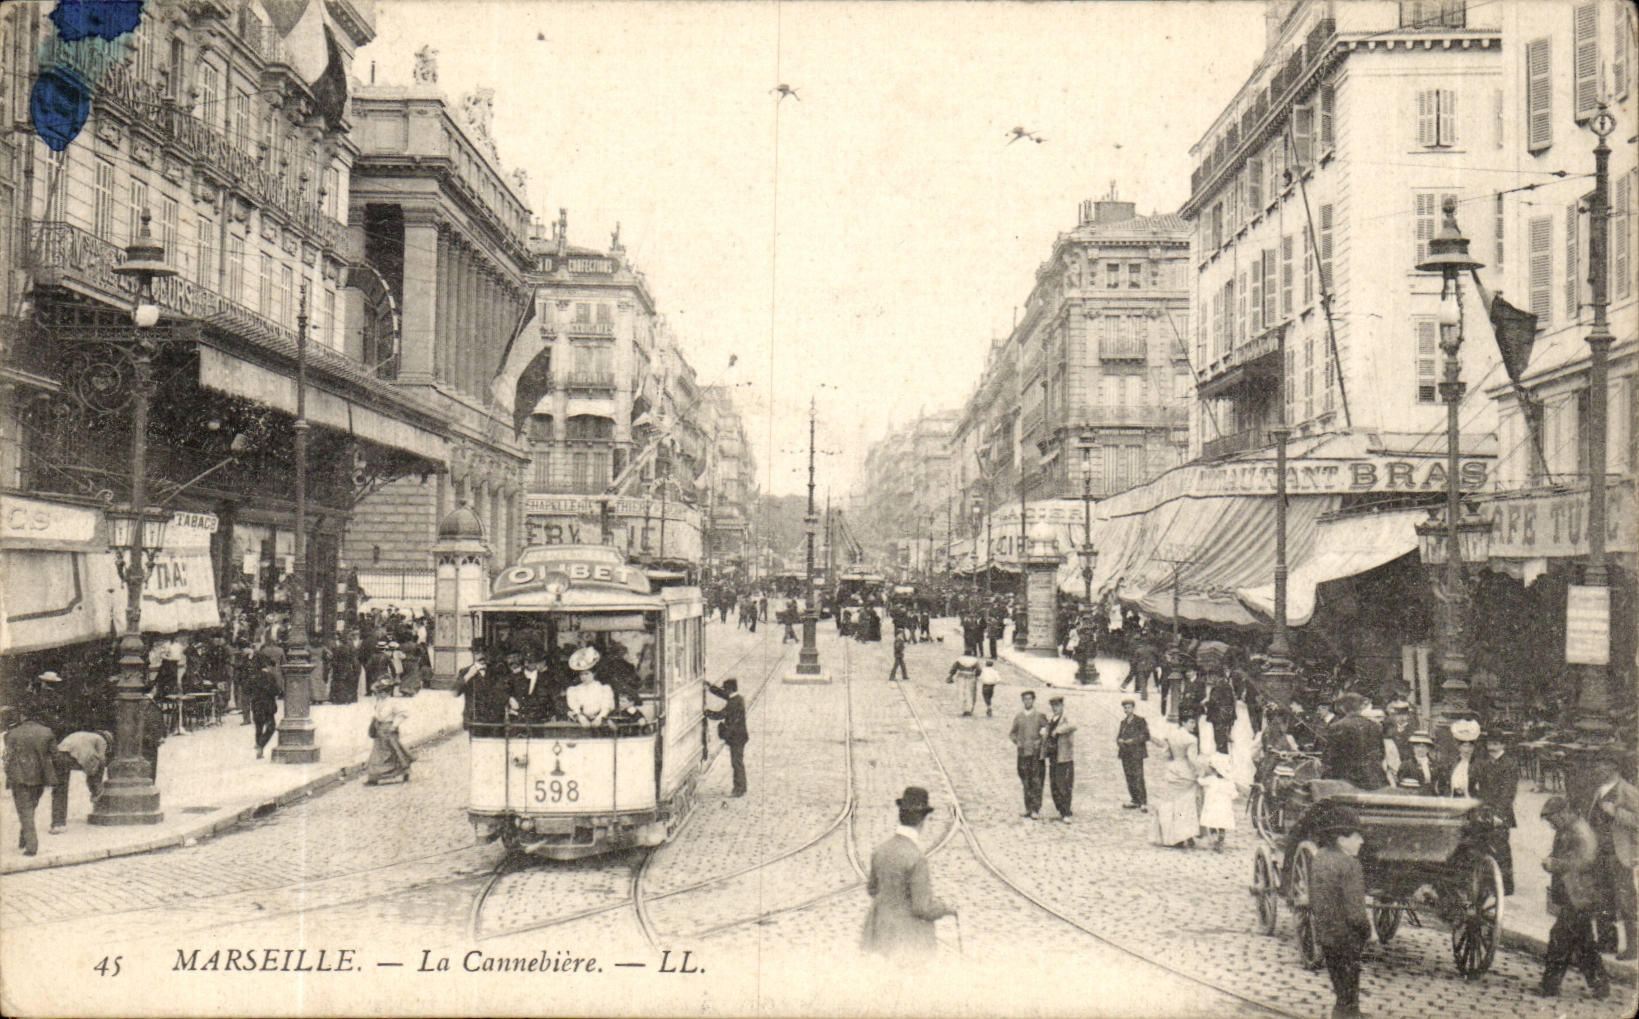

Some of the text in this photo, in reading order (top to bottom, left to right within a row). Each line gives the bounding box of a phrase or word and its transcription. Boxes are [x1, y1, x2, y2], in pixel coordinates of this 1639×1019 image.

[1349, 461, 1488, 490] BRAS
[1551, 491, 1621, 545] TUC
[535, 780, 580, 803] 598
